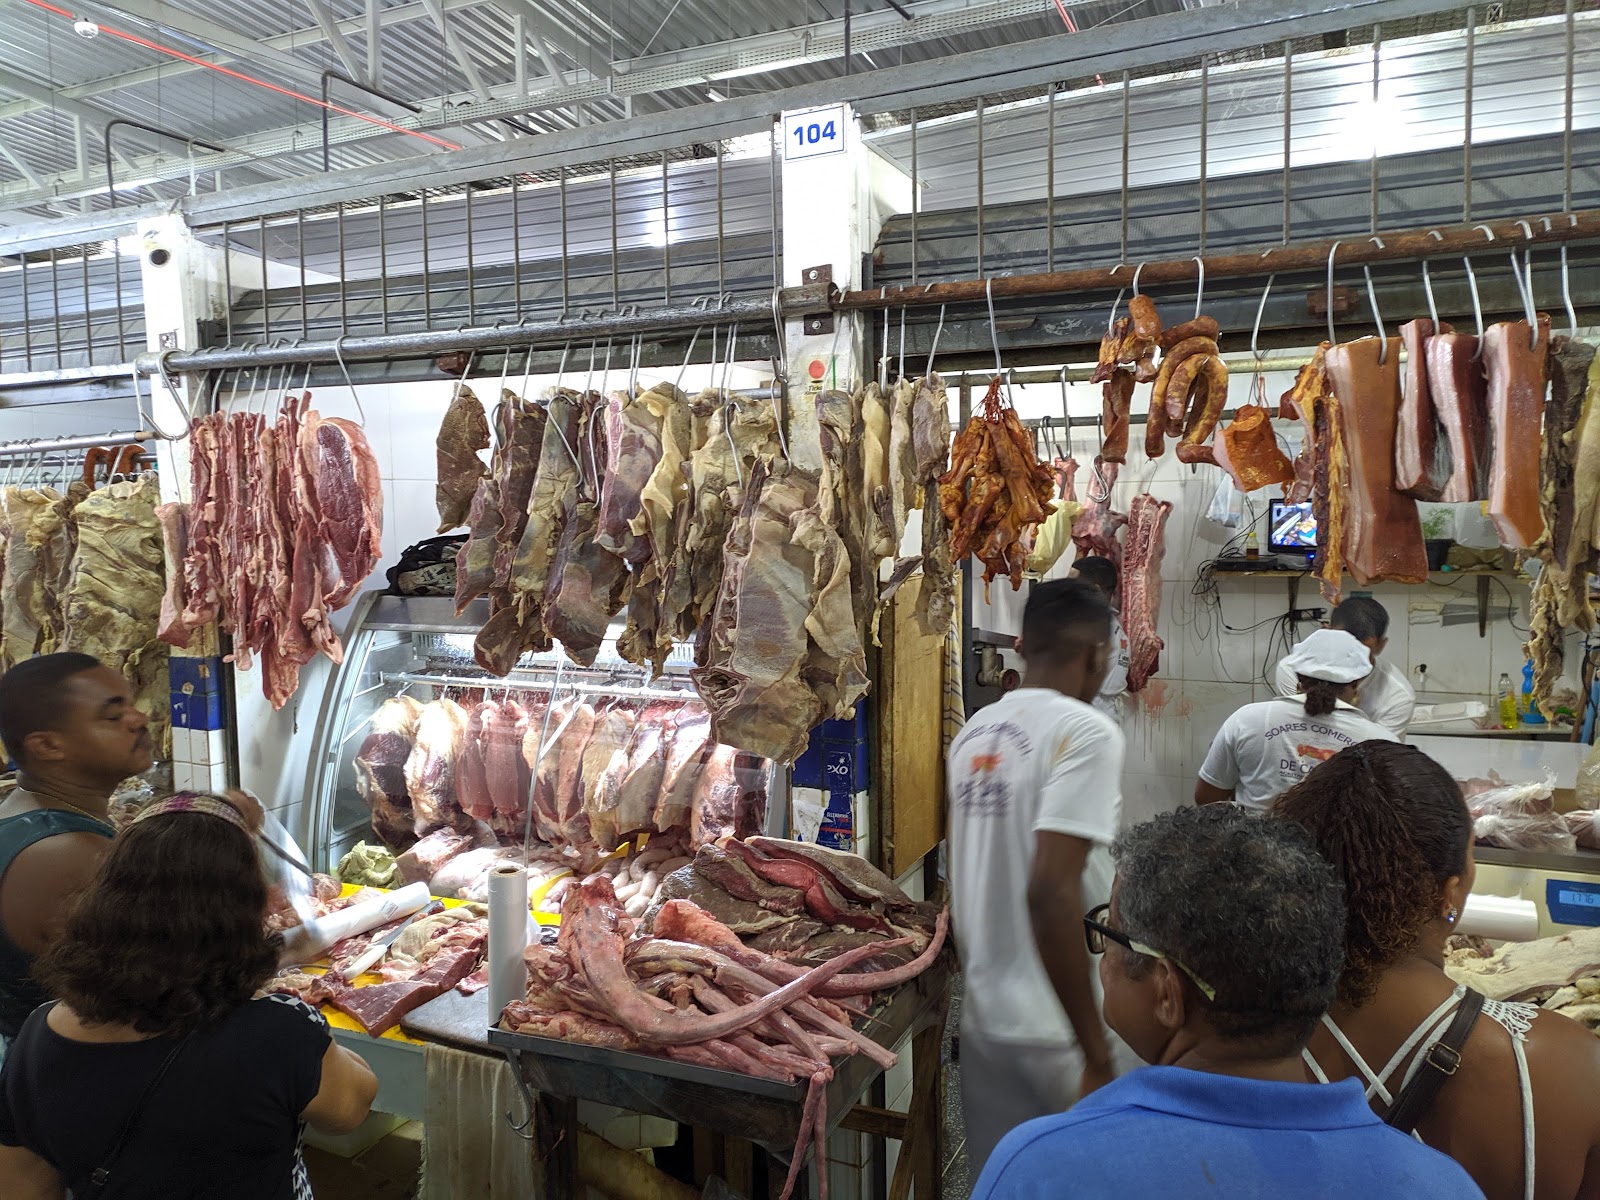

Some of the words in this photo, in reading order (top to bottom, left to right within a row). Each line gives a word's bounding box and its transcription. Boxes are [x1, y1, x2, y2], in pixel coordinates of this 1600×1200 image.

[793, 120, 836, 145] 104
[1264, 723, 1308, 740] SOARES
[1280, 759, 1297, 771] DE
